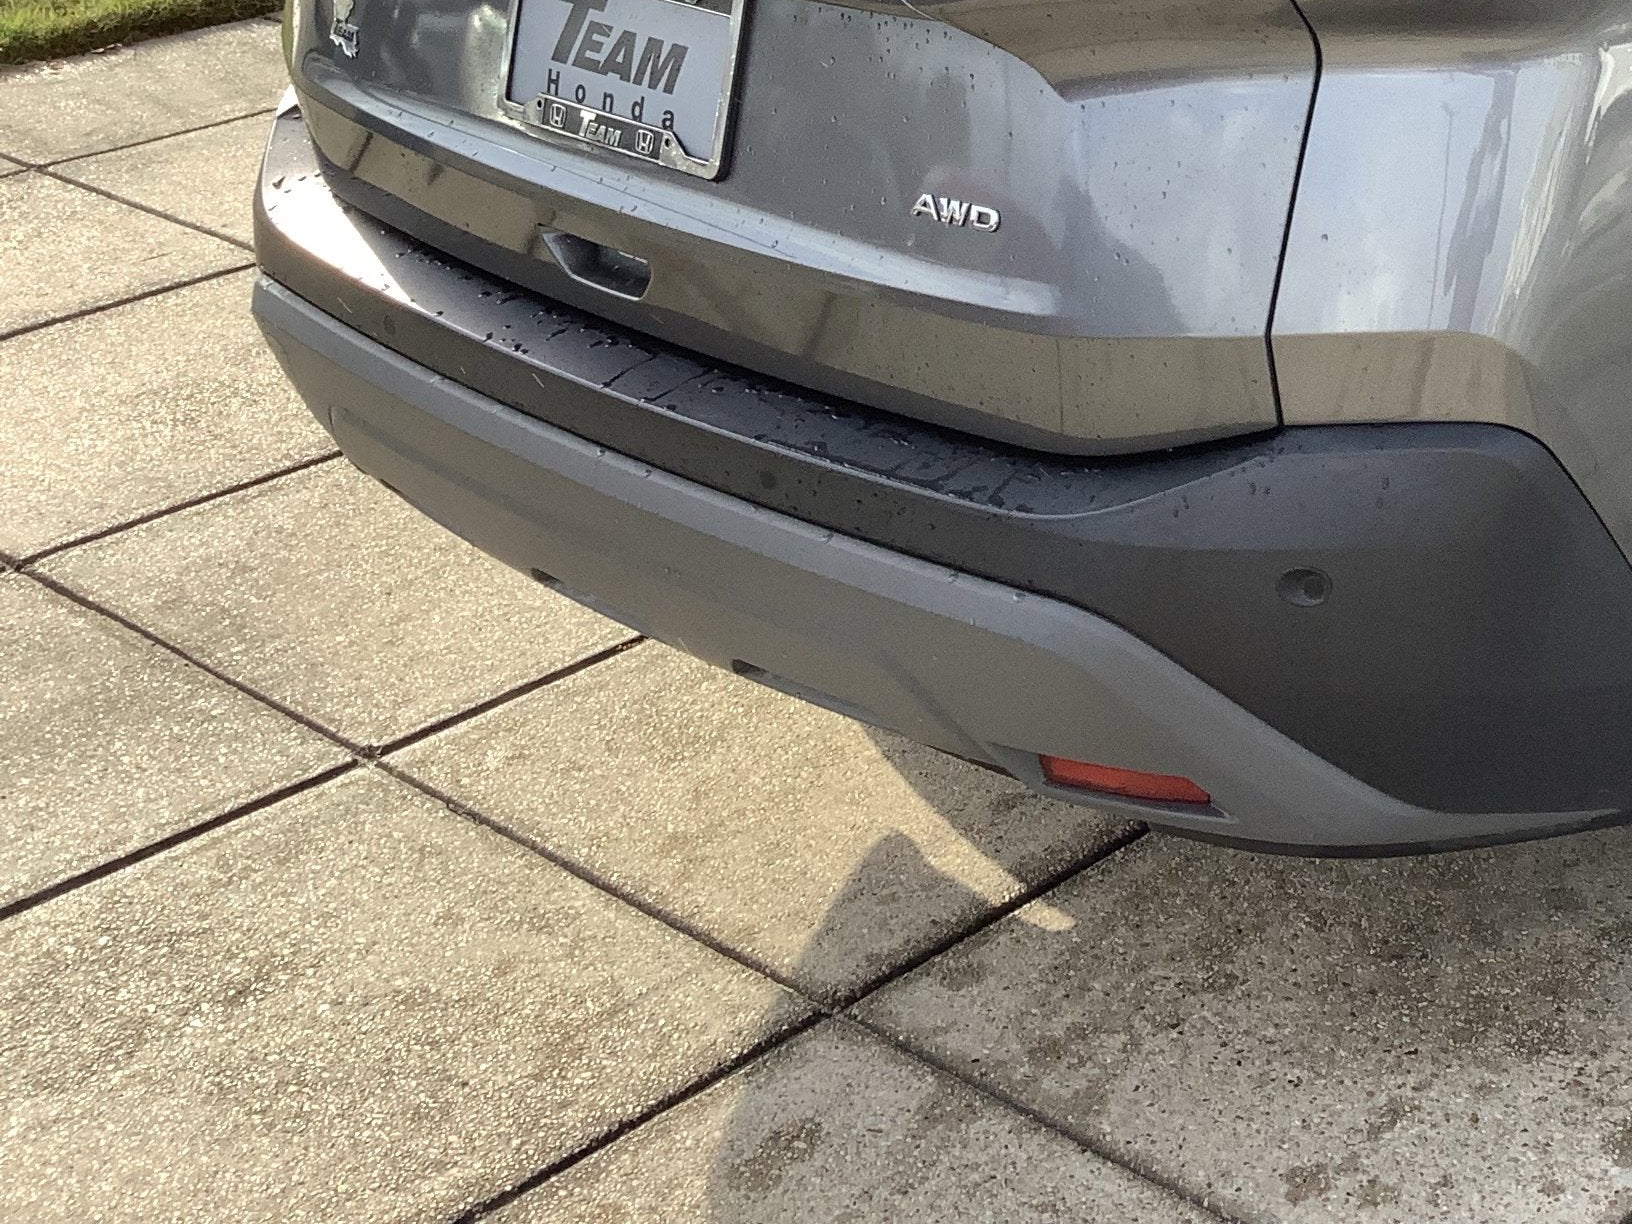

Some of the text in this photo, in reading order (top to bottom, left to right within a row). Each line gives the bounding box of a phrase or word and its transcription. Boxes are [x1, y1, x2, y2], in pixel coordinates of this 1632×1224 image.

[546, 68, 675, 130] Honda
[578, 109, 622, 147] TEAM
[911, 193, 1001, 232] AWD
